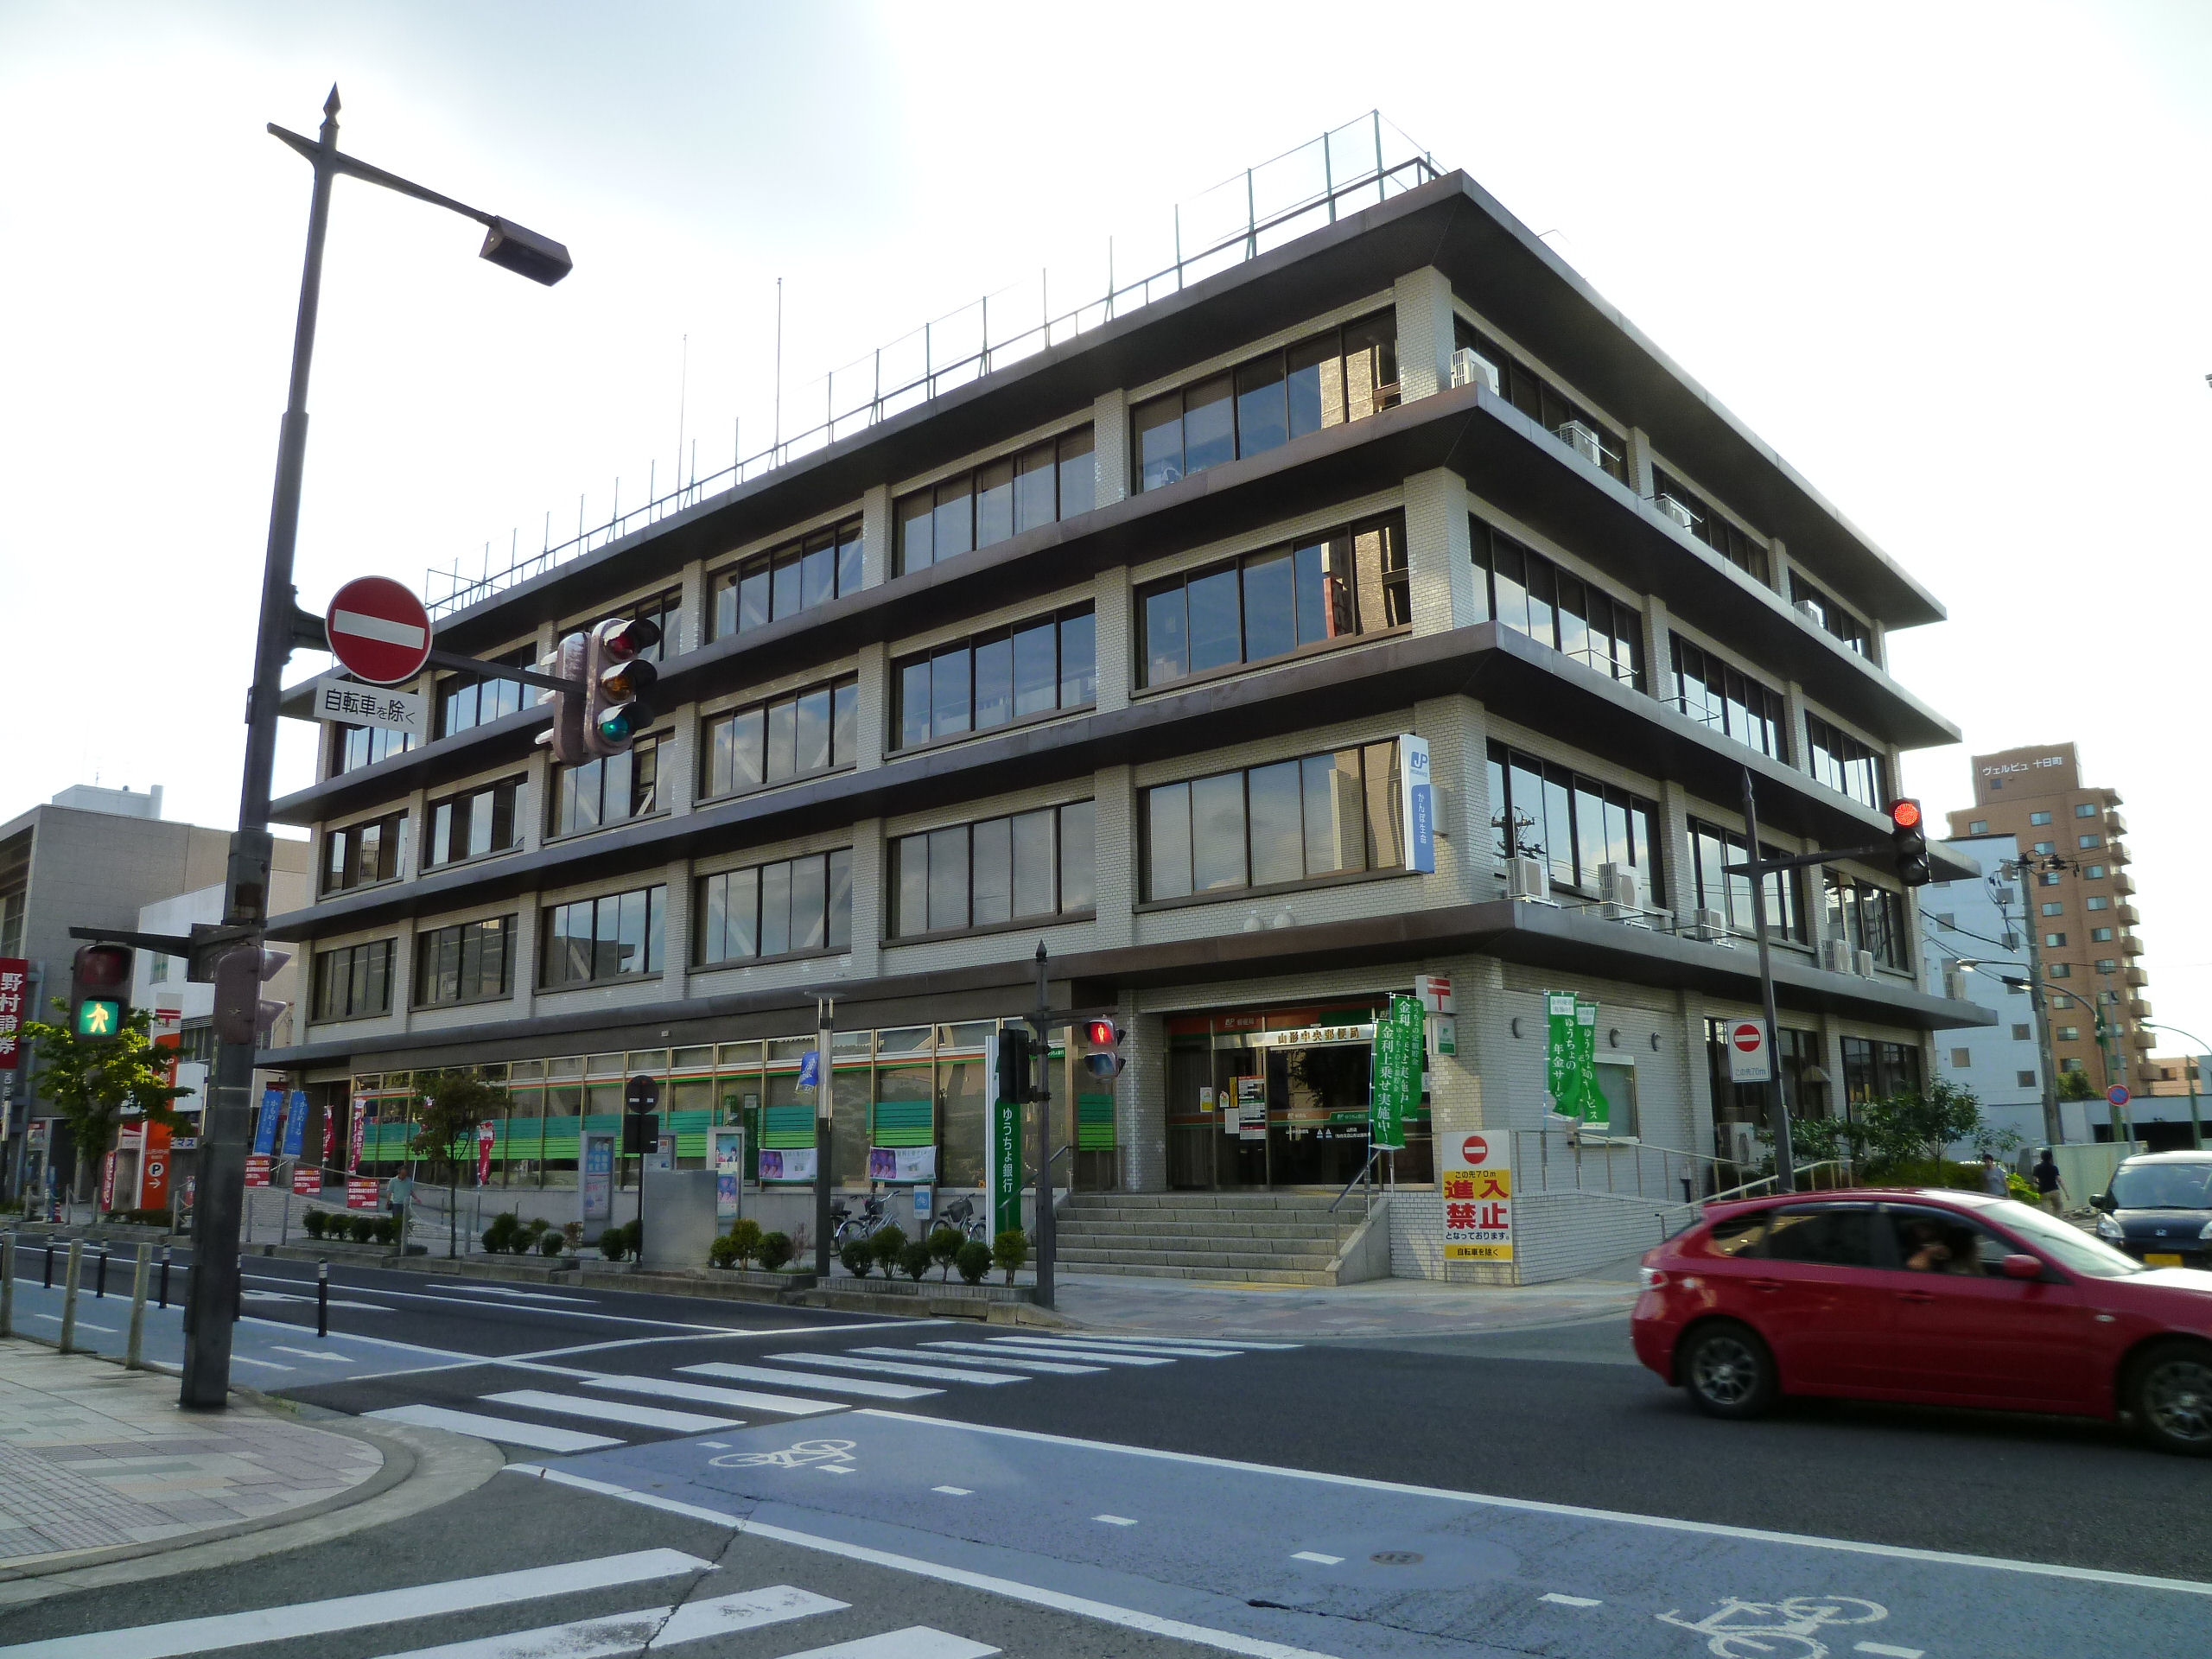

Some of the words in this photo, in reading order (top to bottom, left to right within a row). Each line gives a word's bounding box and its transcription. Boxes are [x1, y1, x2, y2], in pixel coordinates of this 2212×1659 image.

[325, 688, 416, 724] 自転車を除く
[1982, 762, 2029, 776] ヴェルビュ
[2032, 757, 2063, 768] 十日町
[1278, 1027, 1359, 1044] 山形中央郵便局
[1565, 1018, 1576, 1070] ゆうちょの
[266, 1100, 278, 1135] かもめーる
[1002, 1108, 1014, 1193] ゆうちょ銀行
[152, 1165, 162, 1175] P
[1444, 1179, 1510, 1199] 進入
[1446, 1202, 1509, 1230] 禁止
[1446, 1231, 1510, 1240] となっております。
[1457, 1248, 1499, 1256] 自転車を除く
